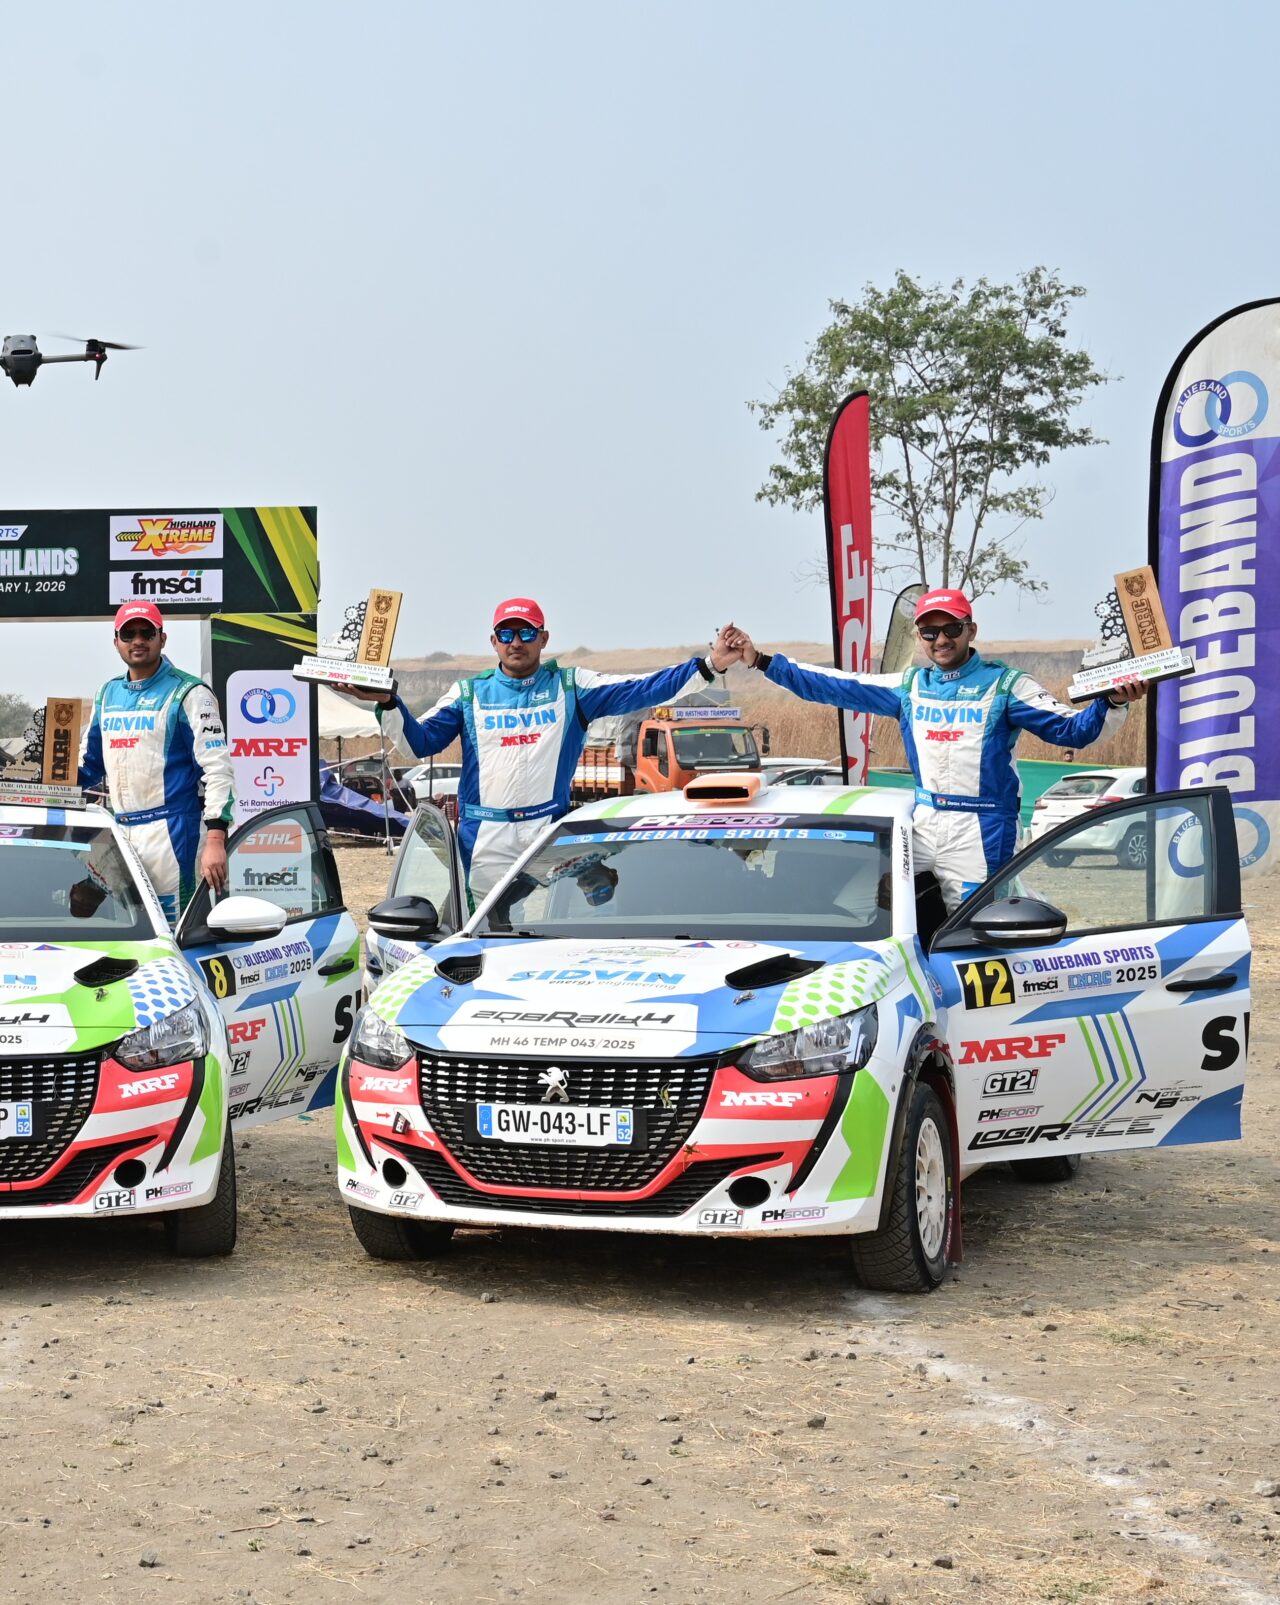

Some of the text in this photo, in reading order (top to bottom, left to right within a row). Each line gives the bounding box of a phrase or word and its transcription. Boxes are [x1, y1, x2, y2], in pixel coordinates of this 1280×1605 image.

[1176, 381, 1227, 414] BLUEBAND
[1217, 420, 1257, 436] SPORTS
[170, 520, 216, 528] HIGHLAND
[131, 518, 215, 551] XTREME
[34, 581, 66, 592] 2026
[131, 573, 202, 594] fmsci
[1179, 451, 1258, 792] BLUEBAND
[244, 689, 272, 700] BLUEBAND
[484, 709, 556, 729] SIDVIN
[915, 706, 983, 723] SIDVIN
[103, 716, 155, 731] SIDVIN
[110, 738, 139, 748] MRF
[500, 733, 541, 747] MRF
[925, 730, 964, 742] MRF
[230, 738, 308, 757] MRF
[245, 833, 295, 845] STIHL
[603, 828, 809, 842] BLUEBAND SPORTS
[243, 868, 299, 885] fmsci
[245, 941, 310, 967] BLUEBAND SPORTS
[1032, 946, 1155, 973] BLUEBAND SPORTS
[210, 959, 227, 998] 8
[240, 958, 311, 985] fmsci 2025
[506, 970, 686, 984] SIDVIN
[1023, 966, 1157, 993] fmsci INRC 2025
[599, 980, 676, 990] engineering
[964, 961, 1012, 1007] 12
[228, 1018, 266, 1044] RF
[490, 1037, 636, 1050] MH 46 TEMP 043/2025
[958, 1033, 1066, 1065] MRF
[118, 1073, 179, 1098] MRF
[360, 1077, 413, 1093] MRF
[982, 1067, 1039, 1098] GT2i
[720, 1090, 802, 1107] MRF
[17, 1122, 30, 1133] 52
[497, 1109, 611, 1136] GW-043-LF
[617, 1127, 631, 1140] 52
[967, 1114, 1164, 1151] LOGIRACE
[95, 1190, 136, 1210] GT2i
[699, 1210, 744, 1227] GT2i
